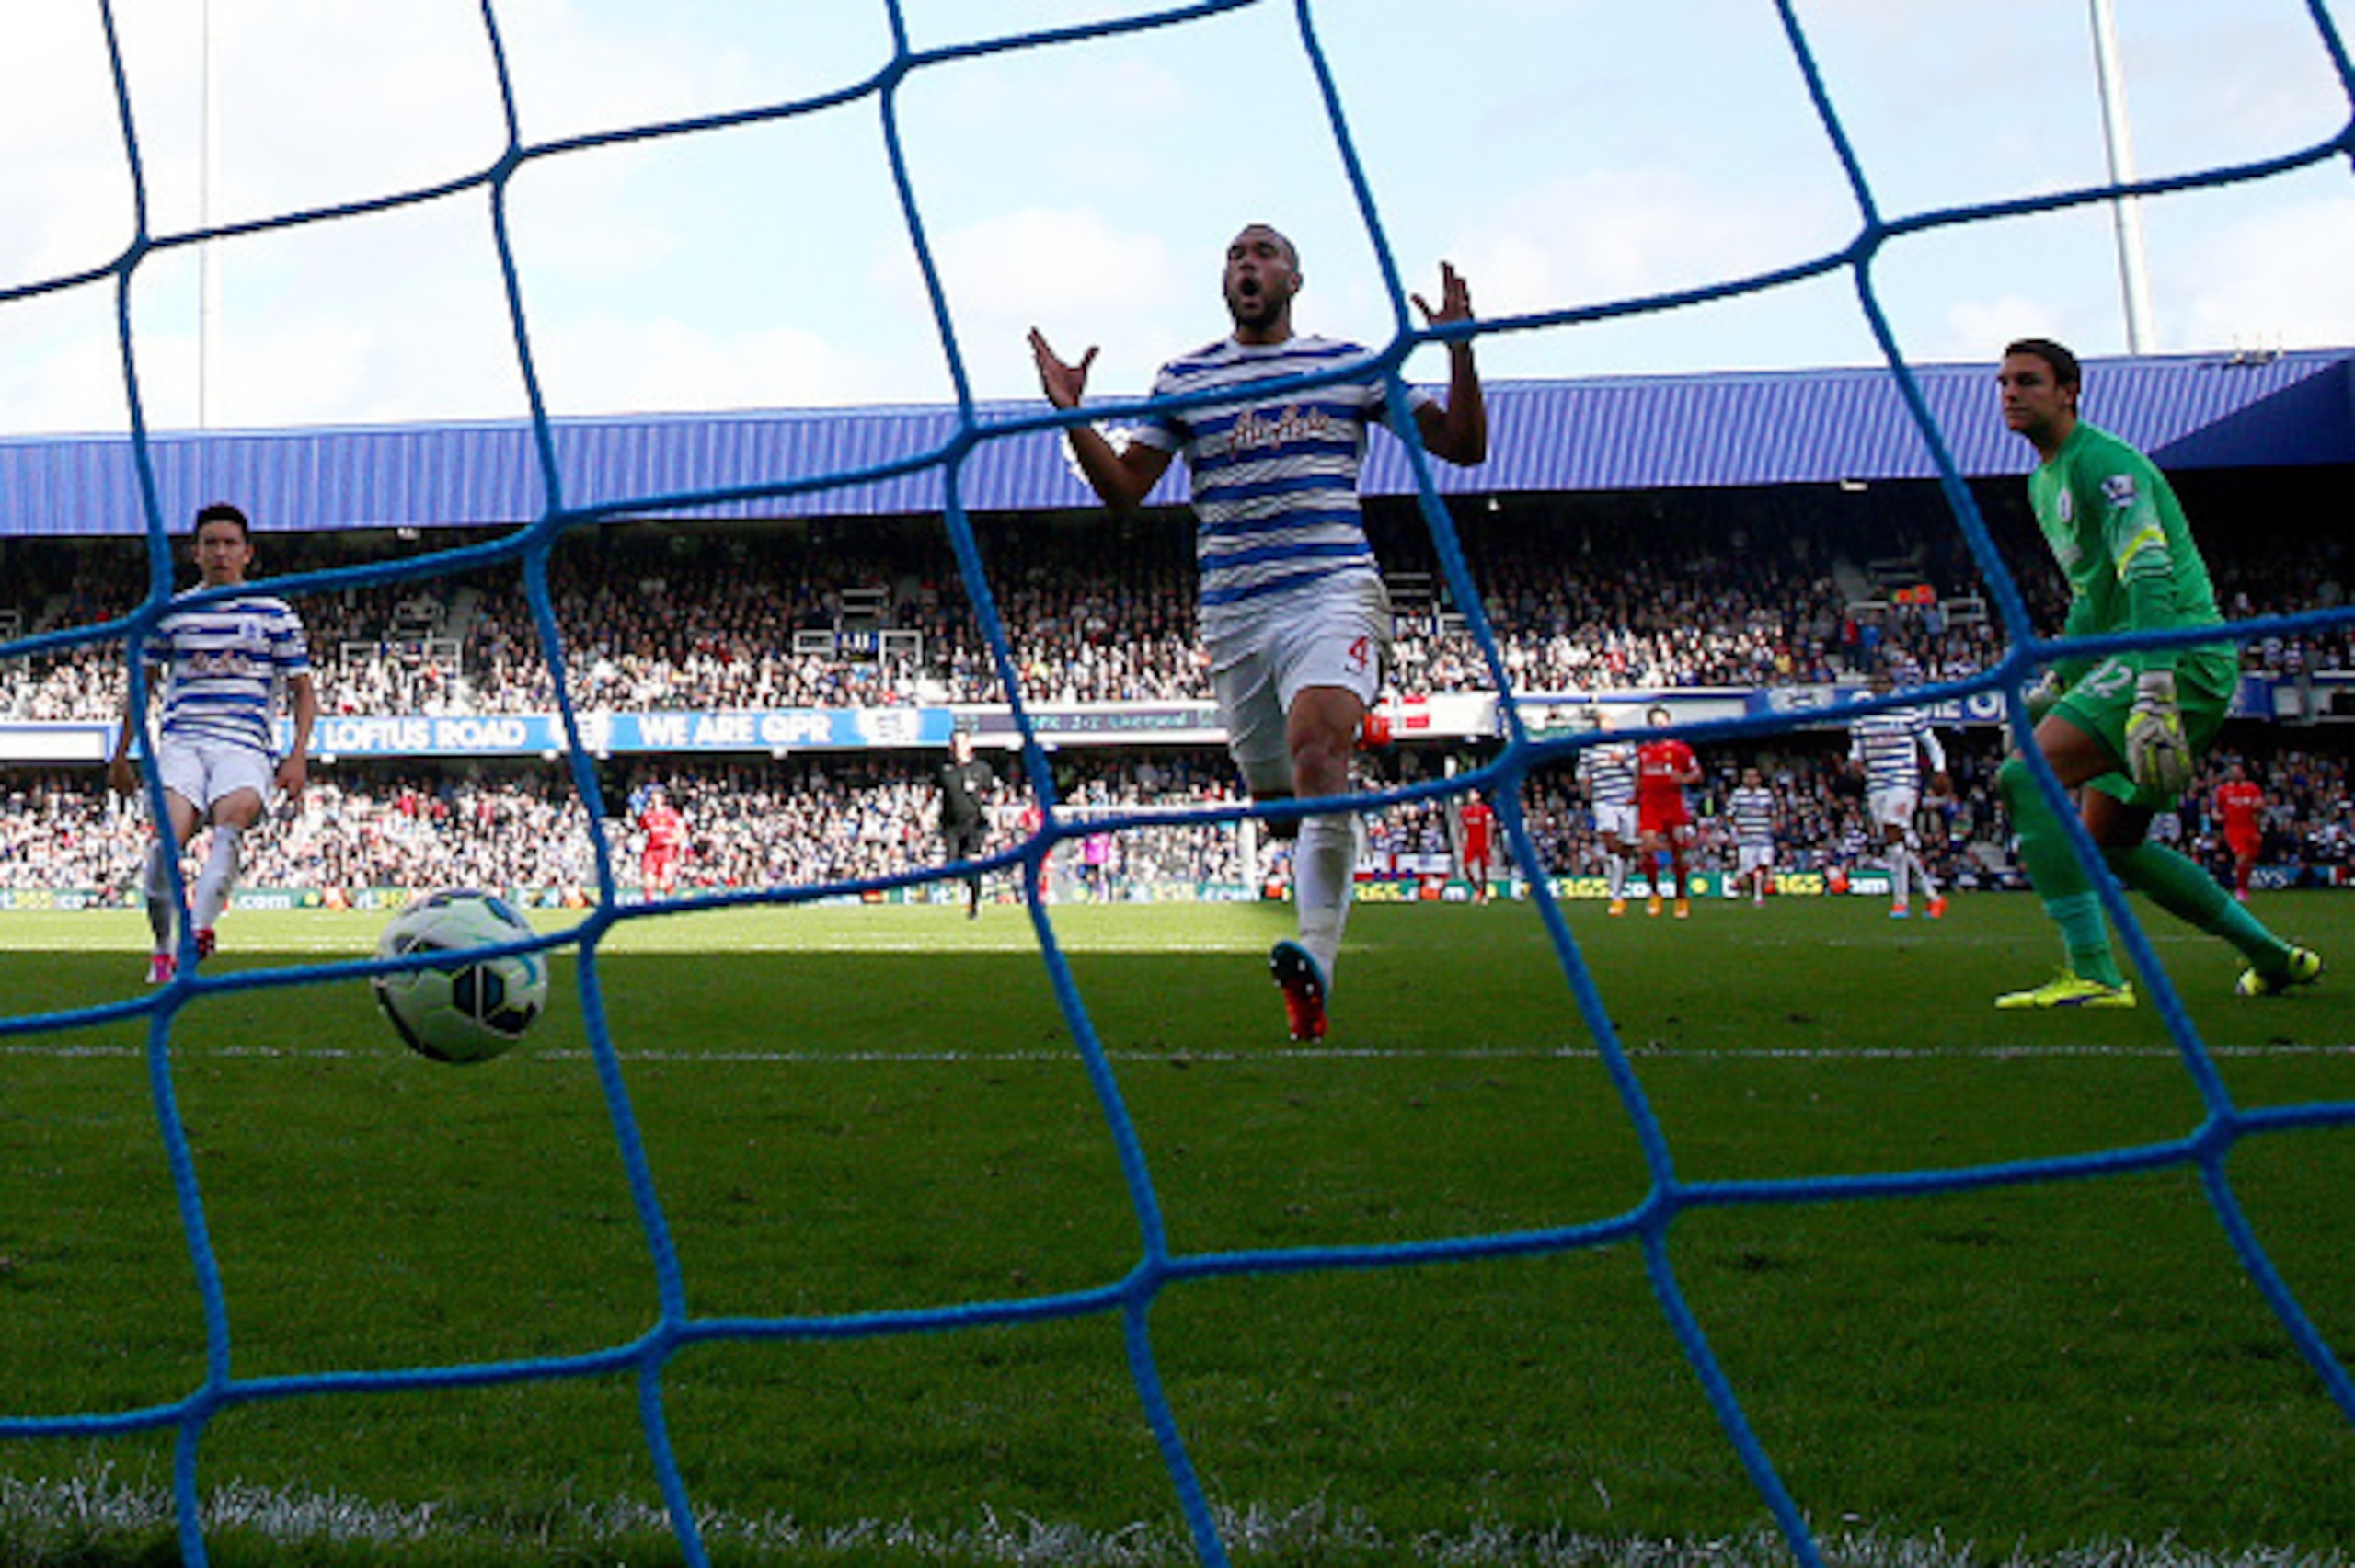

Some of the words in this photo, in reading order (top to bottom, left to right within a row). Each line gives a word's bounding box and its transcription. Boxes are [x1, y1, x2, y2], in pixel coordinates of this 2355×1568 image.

[1349, 636, 1368, 669] 4
[325, 720, 430, 750] LOFTUS
[436, 719, 527, 748] ROAD
[638, 715, 688, 745] WE
[693, 715, 755, 744] ARE
[761, 713, 832, 743] QPR
